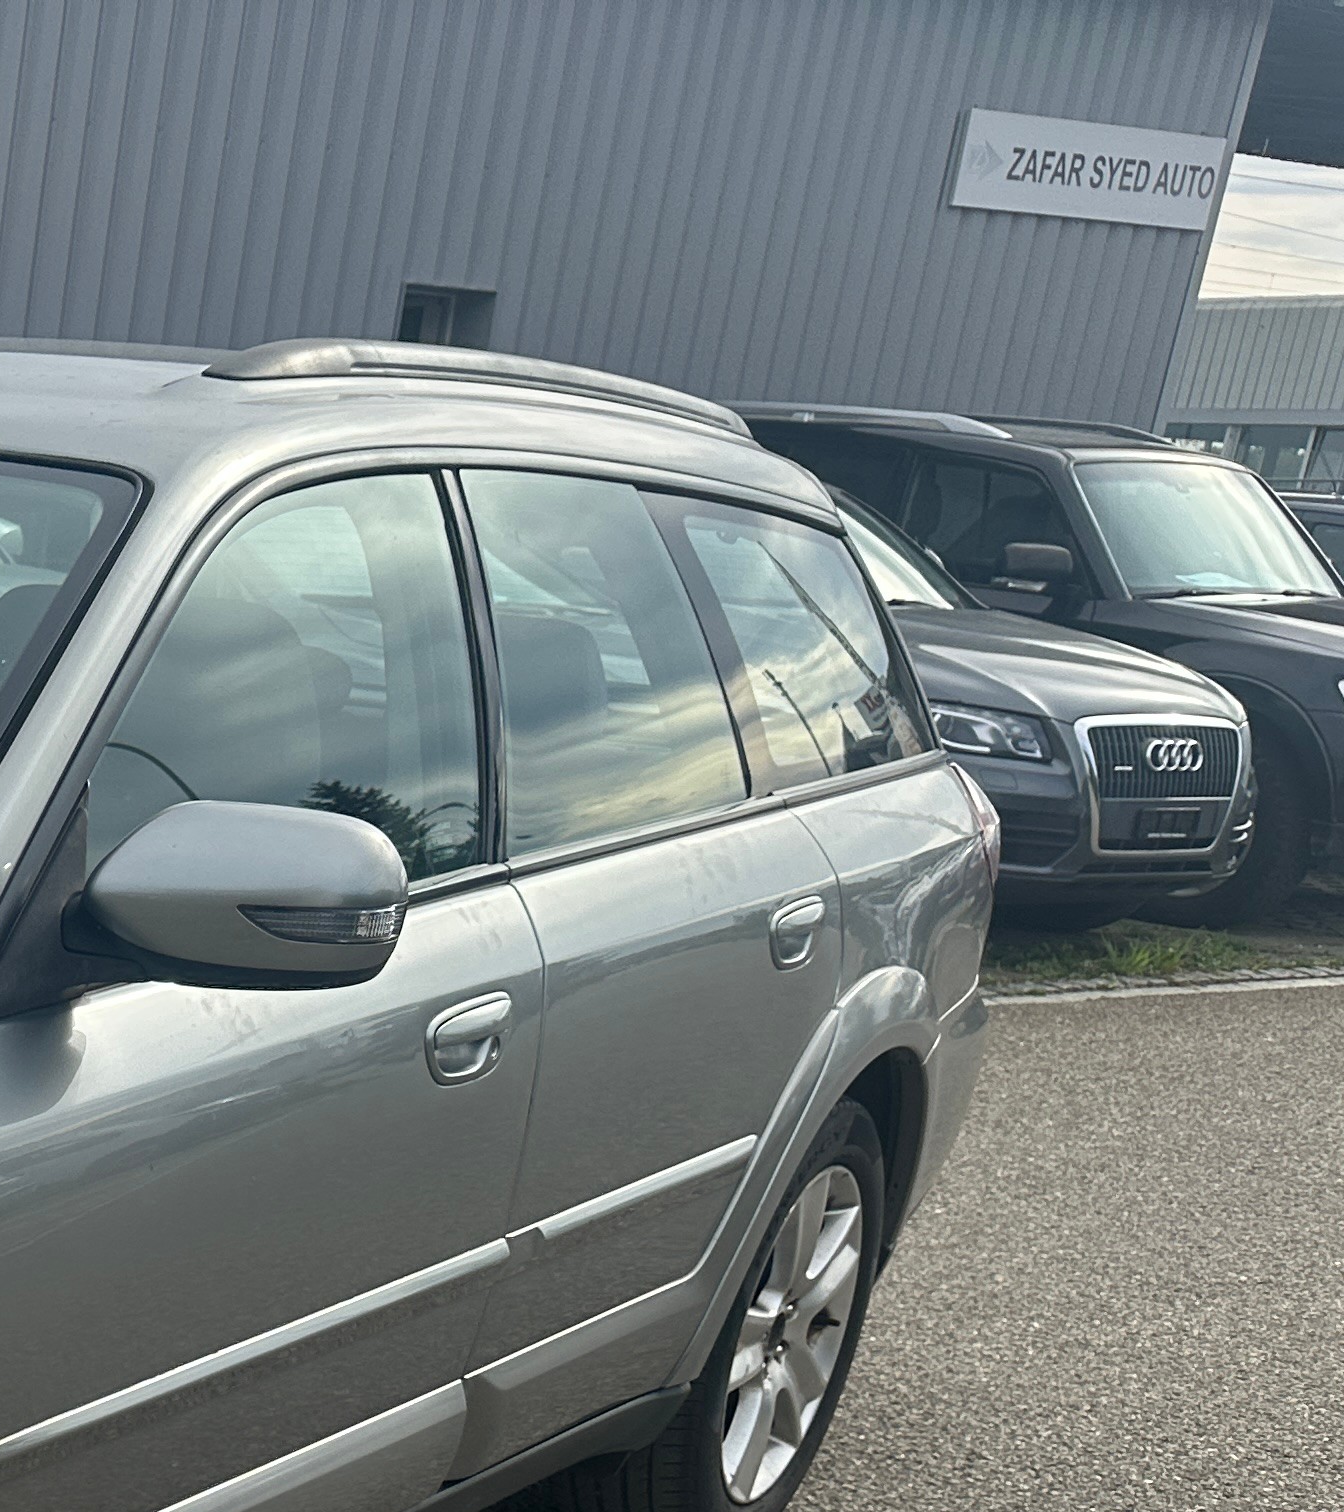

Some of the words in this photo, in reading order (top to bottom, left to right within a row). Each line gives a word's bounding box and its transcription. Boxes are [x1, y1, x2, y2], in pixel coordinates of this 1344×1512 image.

[1005, 147, 1085, 187] ZAFAR
[1089, 155, 1151, 193] SYED
[1152, 162, 1216, 199] AUTO
